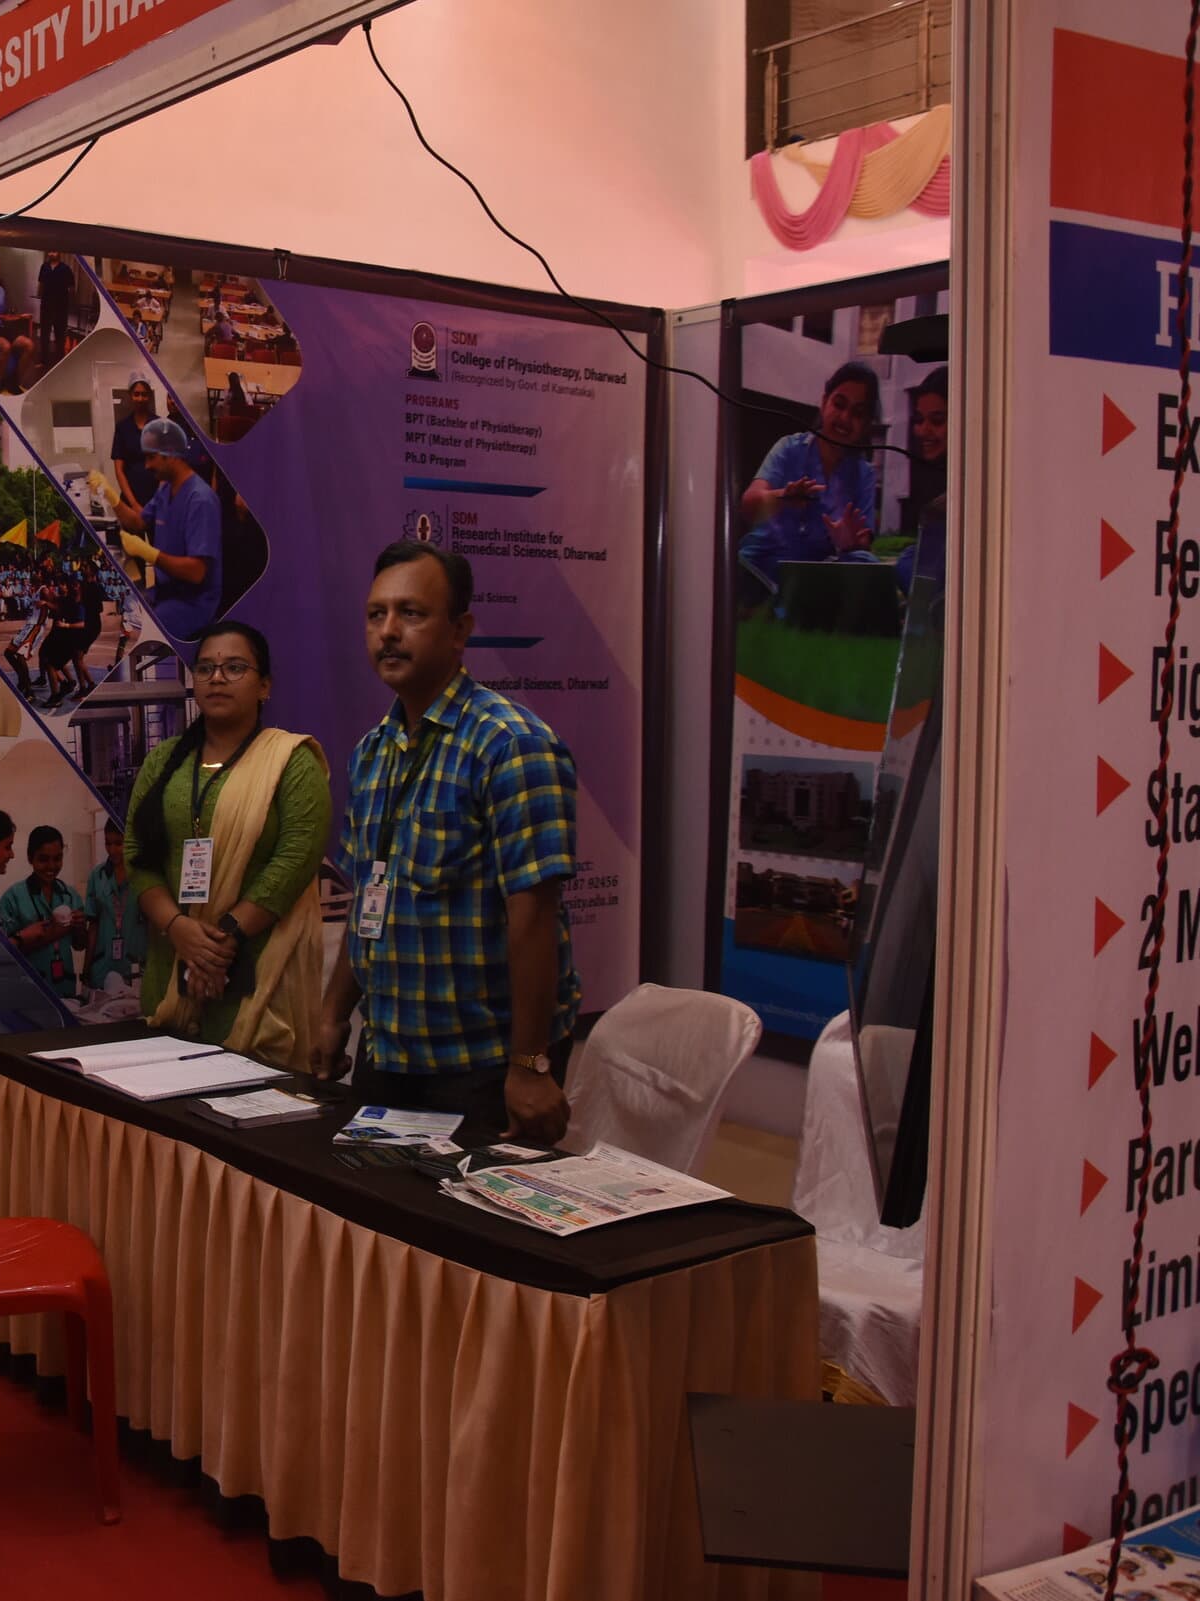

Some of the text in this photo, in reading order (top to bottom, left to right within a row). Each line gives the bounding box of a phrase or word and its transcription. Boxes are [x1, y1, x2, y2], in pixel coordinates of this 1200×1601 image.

[451, 331, 478, 346] SDM
[451, 351, 627, 385] College of Physiotherapy, Dharwad
[451, 371, 504, 388] (Recognized
[505, 377, 516, 391] by
[405, 394, 460, 410] PROGRAMS
[405, 412, 543, 439] BPT (Bachelor of Physiotherapy)
[405, 431, 537, 456] MPT (Master of Physiotherapy)
[405, 451, 467, 469] Ph.D Program
[452, 511, 478, 525] SDM
[452, 526, 563, 545] Research Institute for
[452, 541, 607, 561] Biomedical Sciences, Dharwad
[567, 676, 609, 690] Dharwad
[1138, 894, 1164, 970] 2
